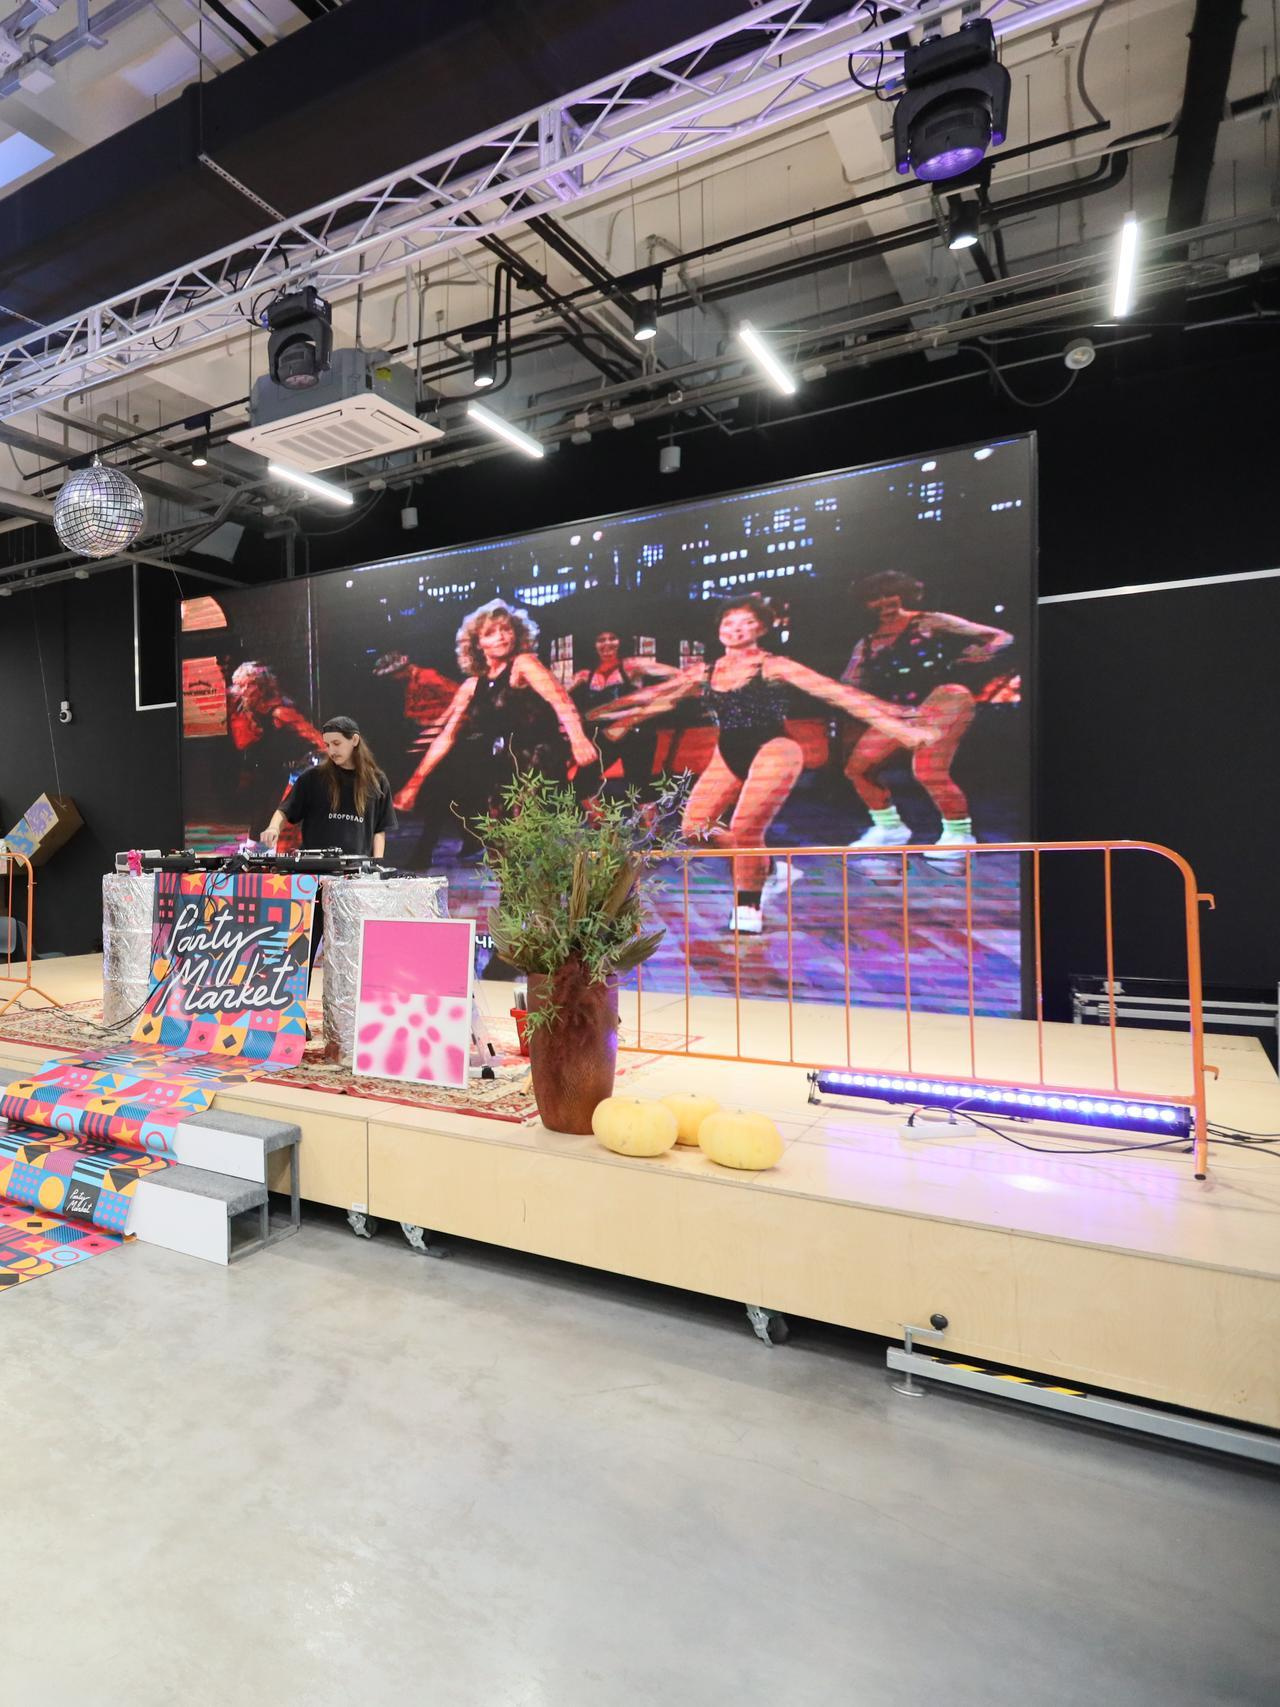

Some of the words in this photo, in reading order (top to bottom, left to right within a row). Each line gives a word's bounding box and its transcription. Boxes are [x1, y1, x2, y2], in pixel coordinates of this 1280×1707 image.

[166, 903, 274, 988] Party
[155, 952, 294, 1014] Market
[69, 1188, 91, 1208] Party
